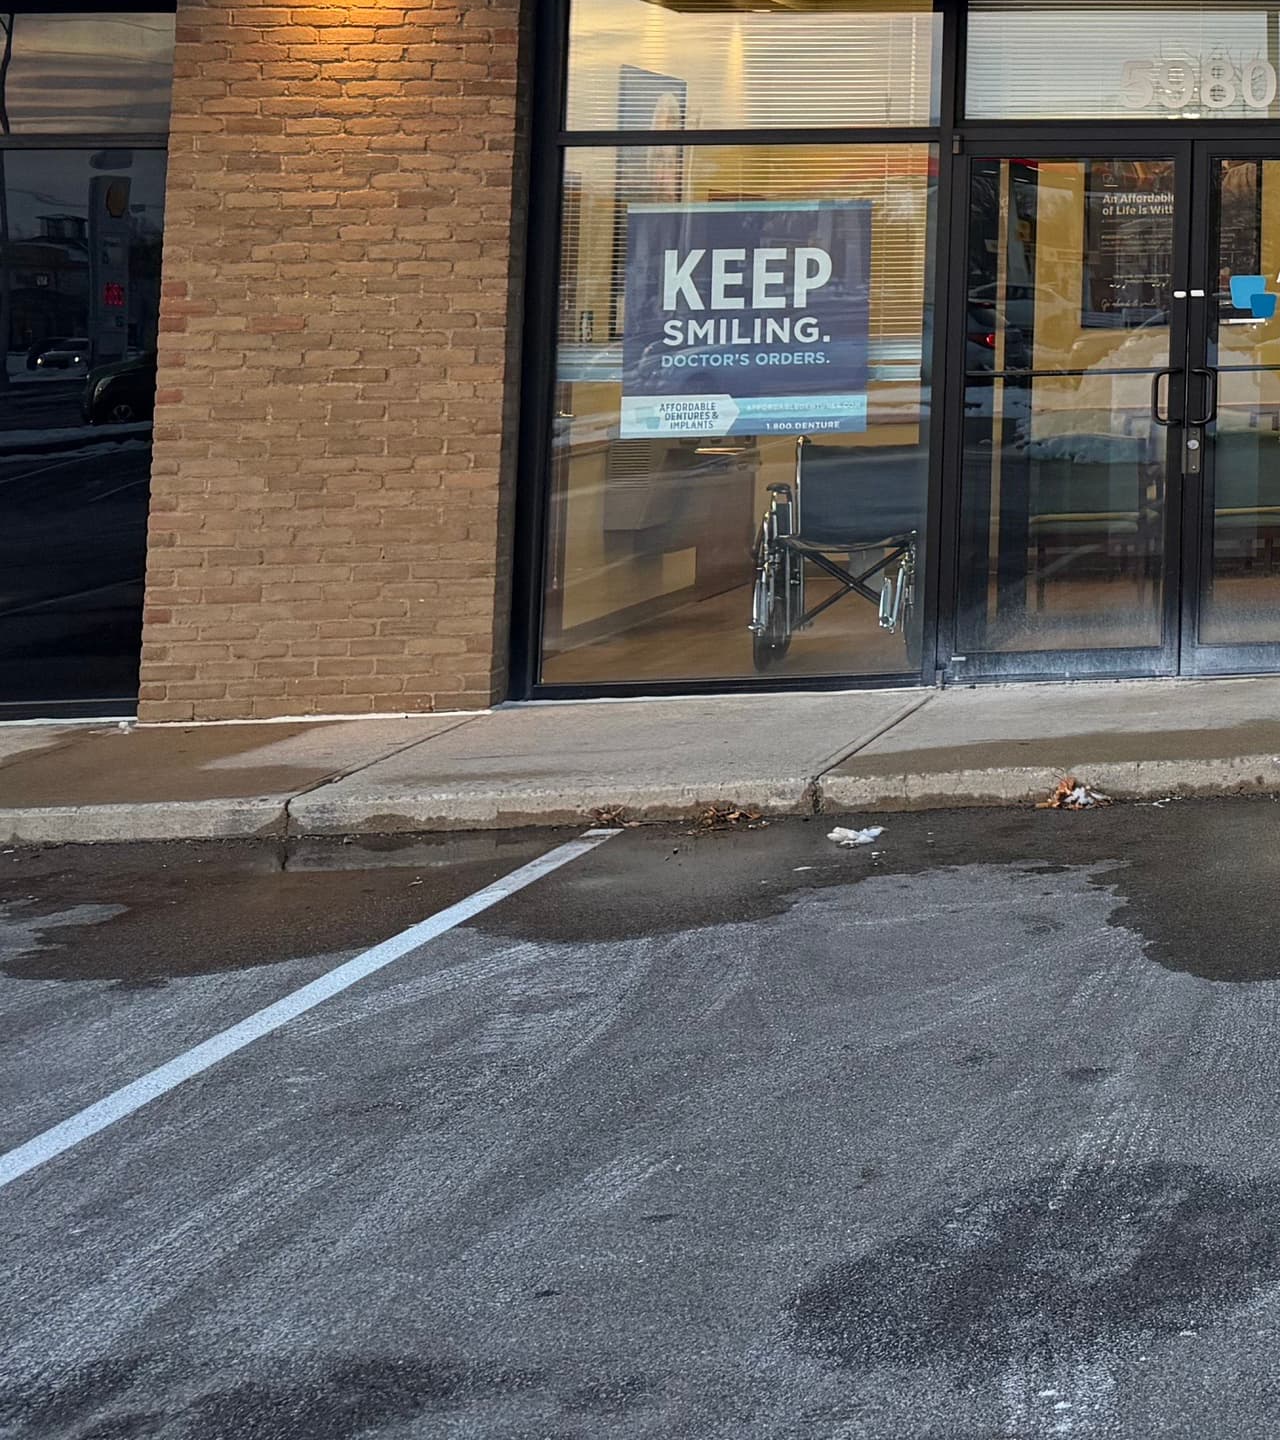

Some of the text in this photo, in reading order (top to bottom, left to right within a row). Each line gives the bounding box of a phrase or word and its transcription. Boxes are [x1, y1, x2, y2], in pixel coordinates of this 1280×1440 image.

[1120, 60, 1277, 109] 5980
[1102, 206, 1114, 215] of
[1117, 205, 1136, 215] Life
[663, 248, 832, 310] KEEP
[662, 317, 831, 346] SMILING.
[661, 351, 831, 368] DOCTOR'S ORDERS.
[659, 402, 716, 413] AFFORDABLE
[664, 411, 719, 421] DENTURES &
[669, 420, 714, 430] IMPLANTS
